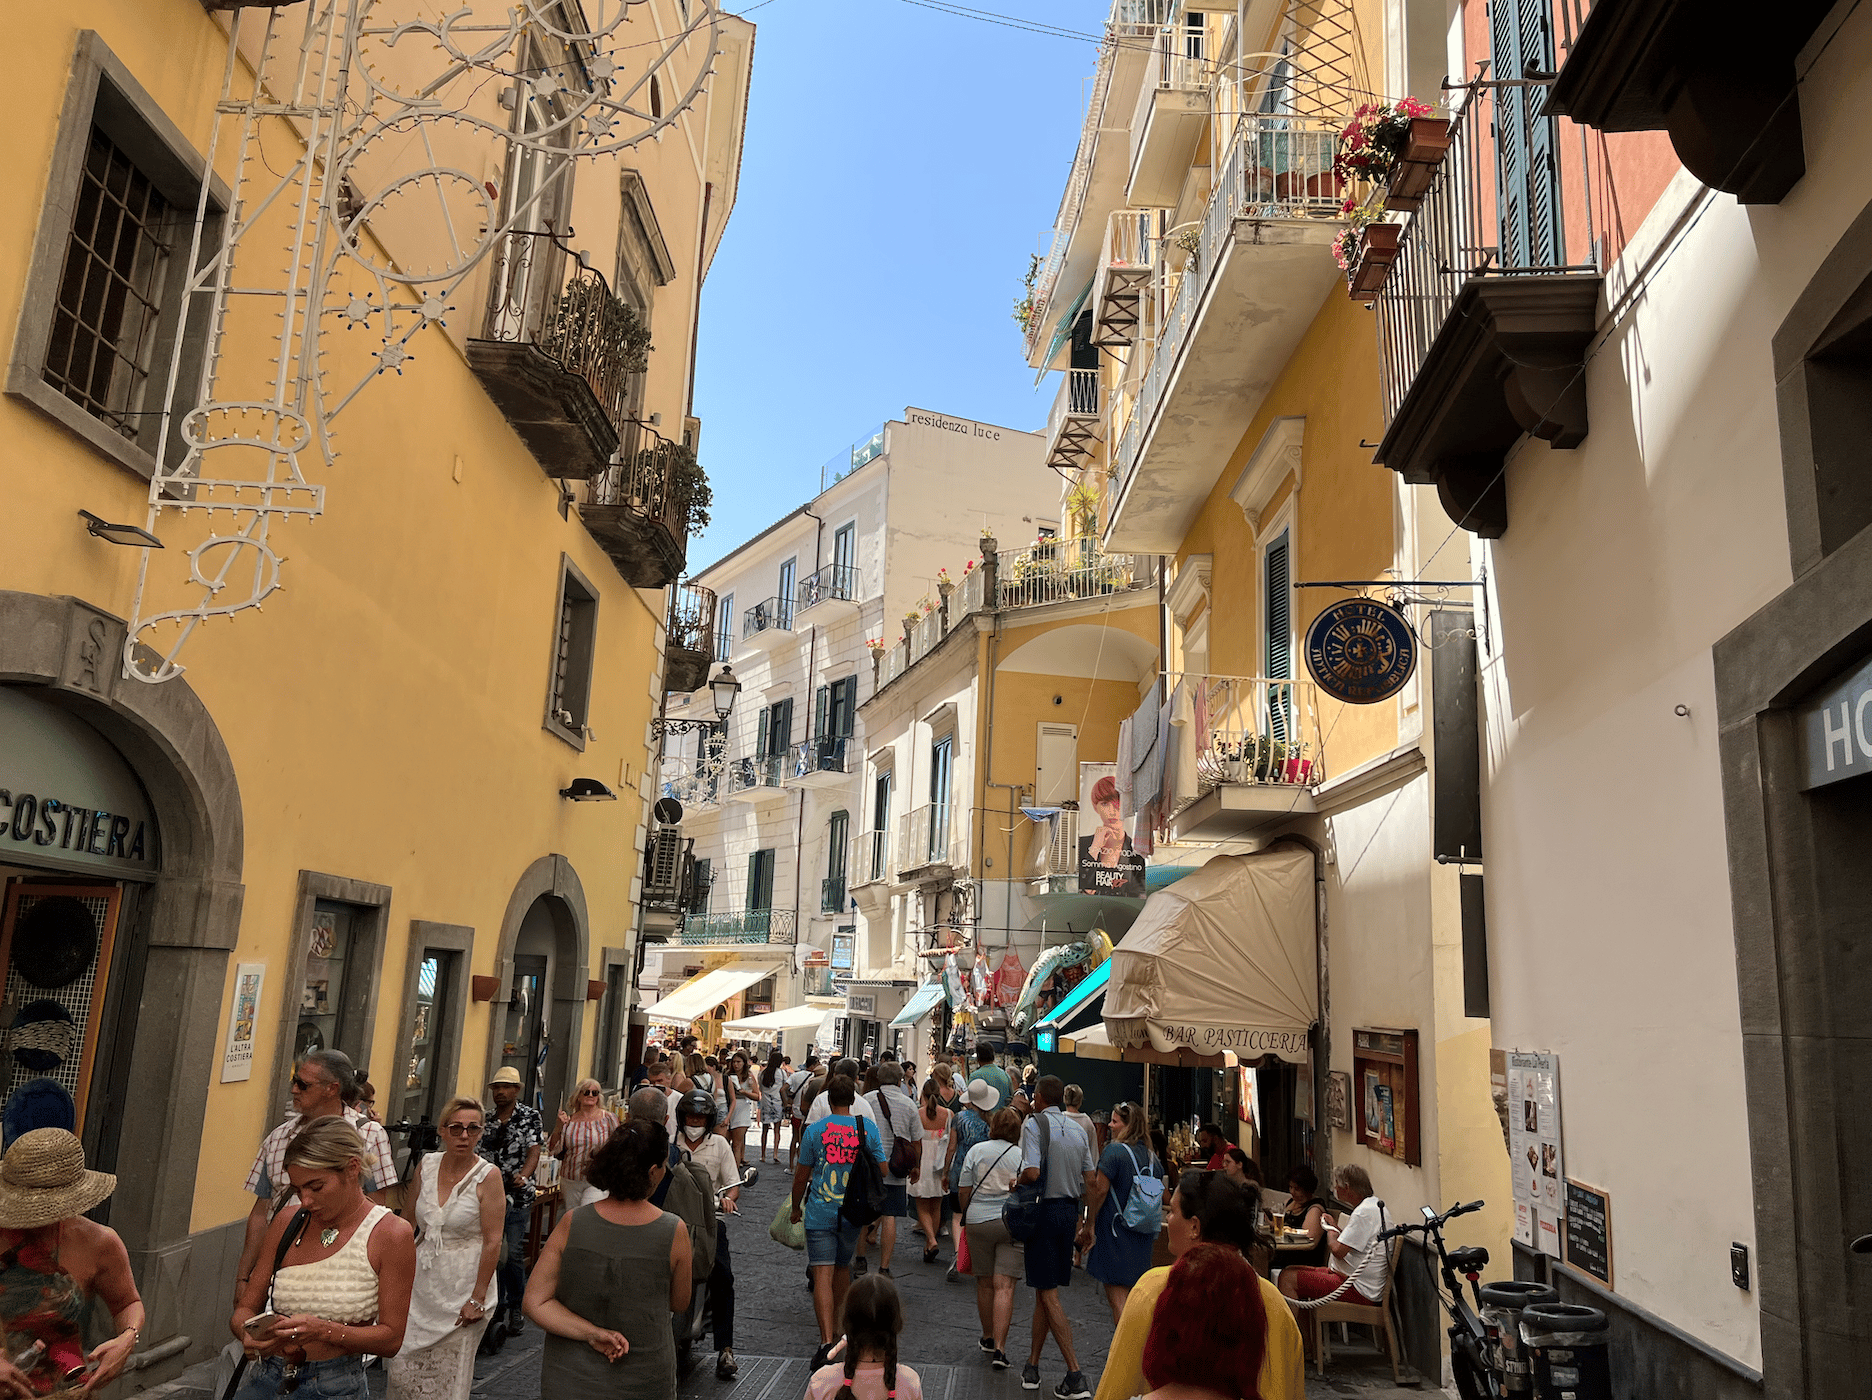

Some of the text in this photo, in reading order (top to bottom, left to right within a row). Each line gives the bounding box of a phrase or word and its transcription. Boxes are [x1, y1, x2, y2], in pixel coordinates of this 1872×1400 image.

[911, 413, 1000, 441] residenza luce
[1333, 605, 1385, 621] HOTEL
[1095, 870, 1124, 880] BEAUTY
[1163, 1025, 1199, 1047] BAR
[1204, 1027, 1308, 1054] PASTICCERIA
[230, 1043, 251, 1053] L'ALTRA
[226, 1052, 253, 1063] COSTIERA
